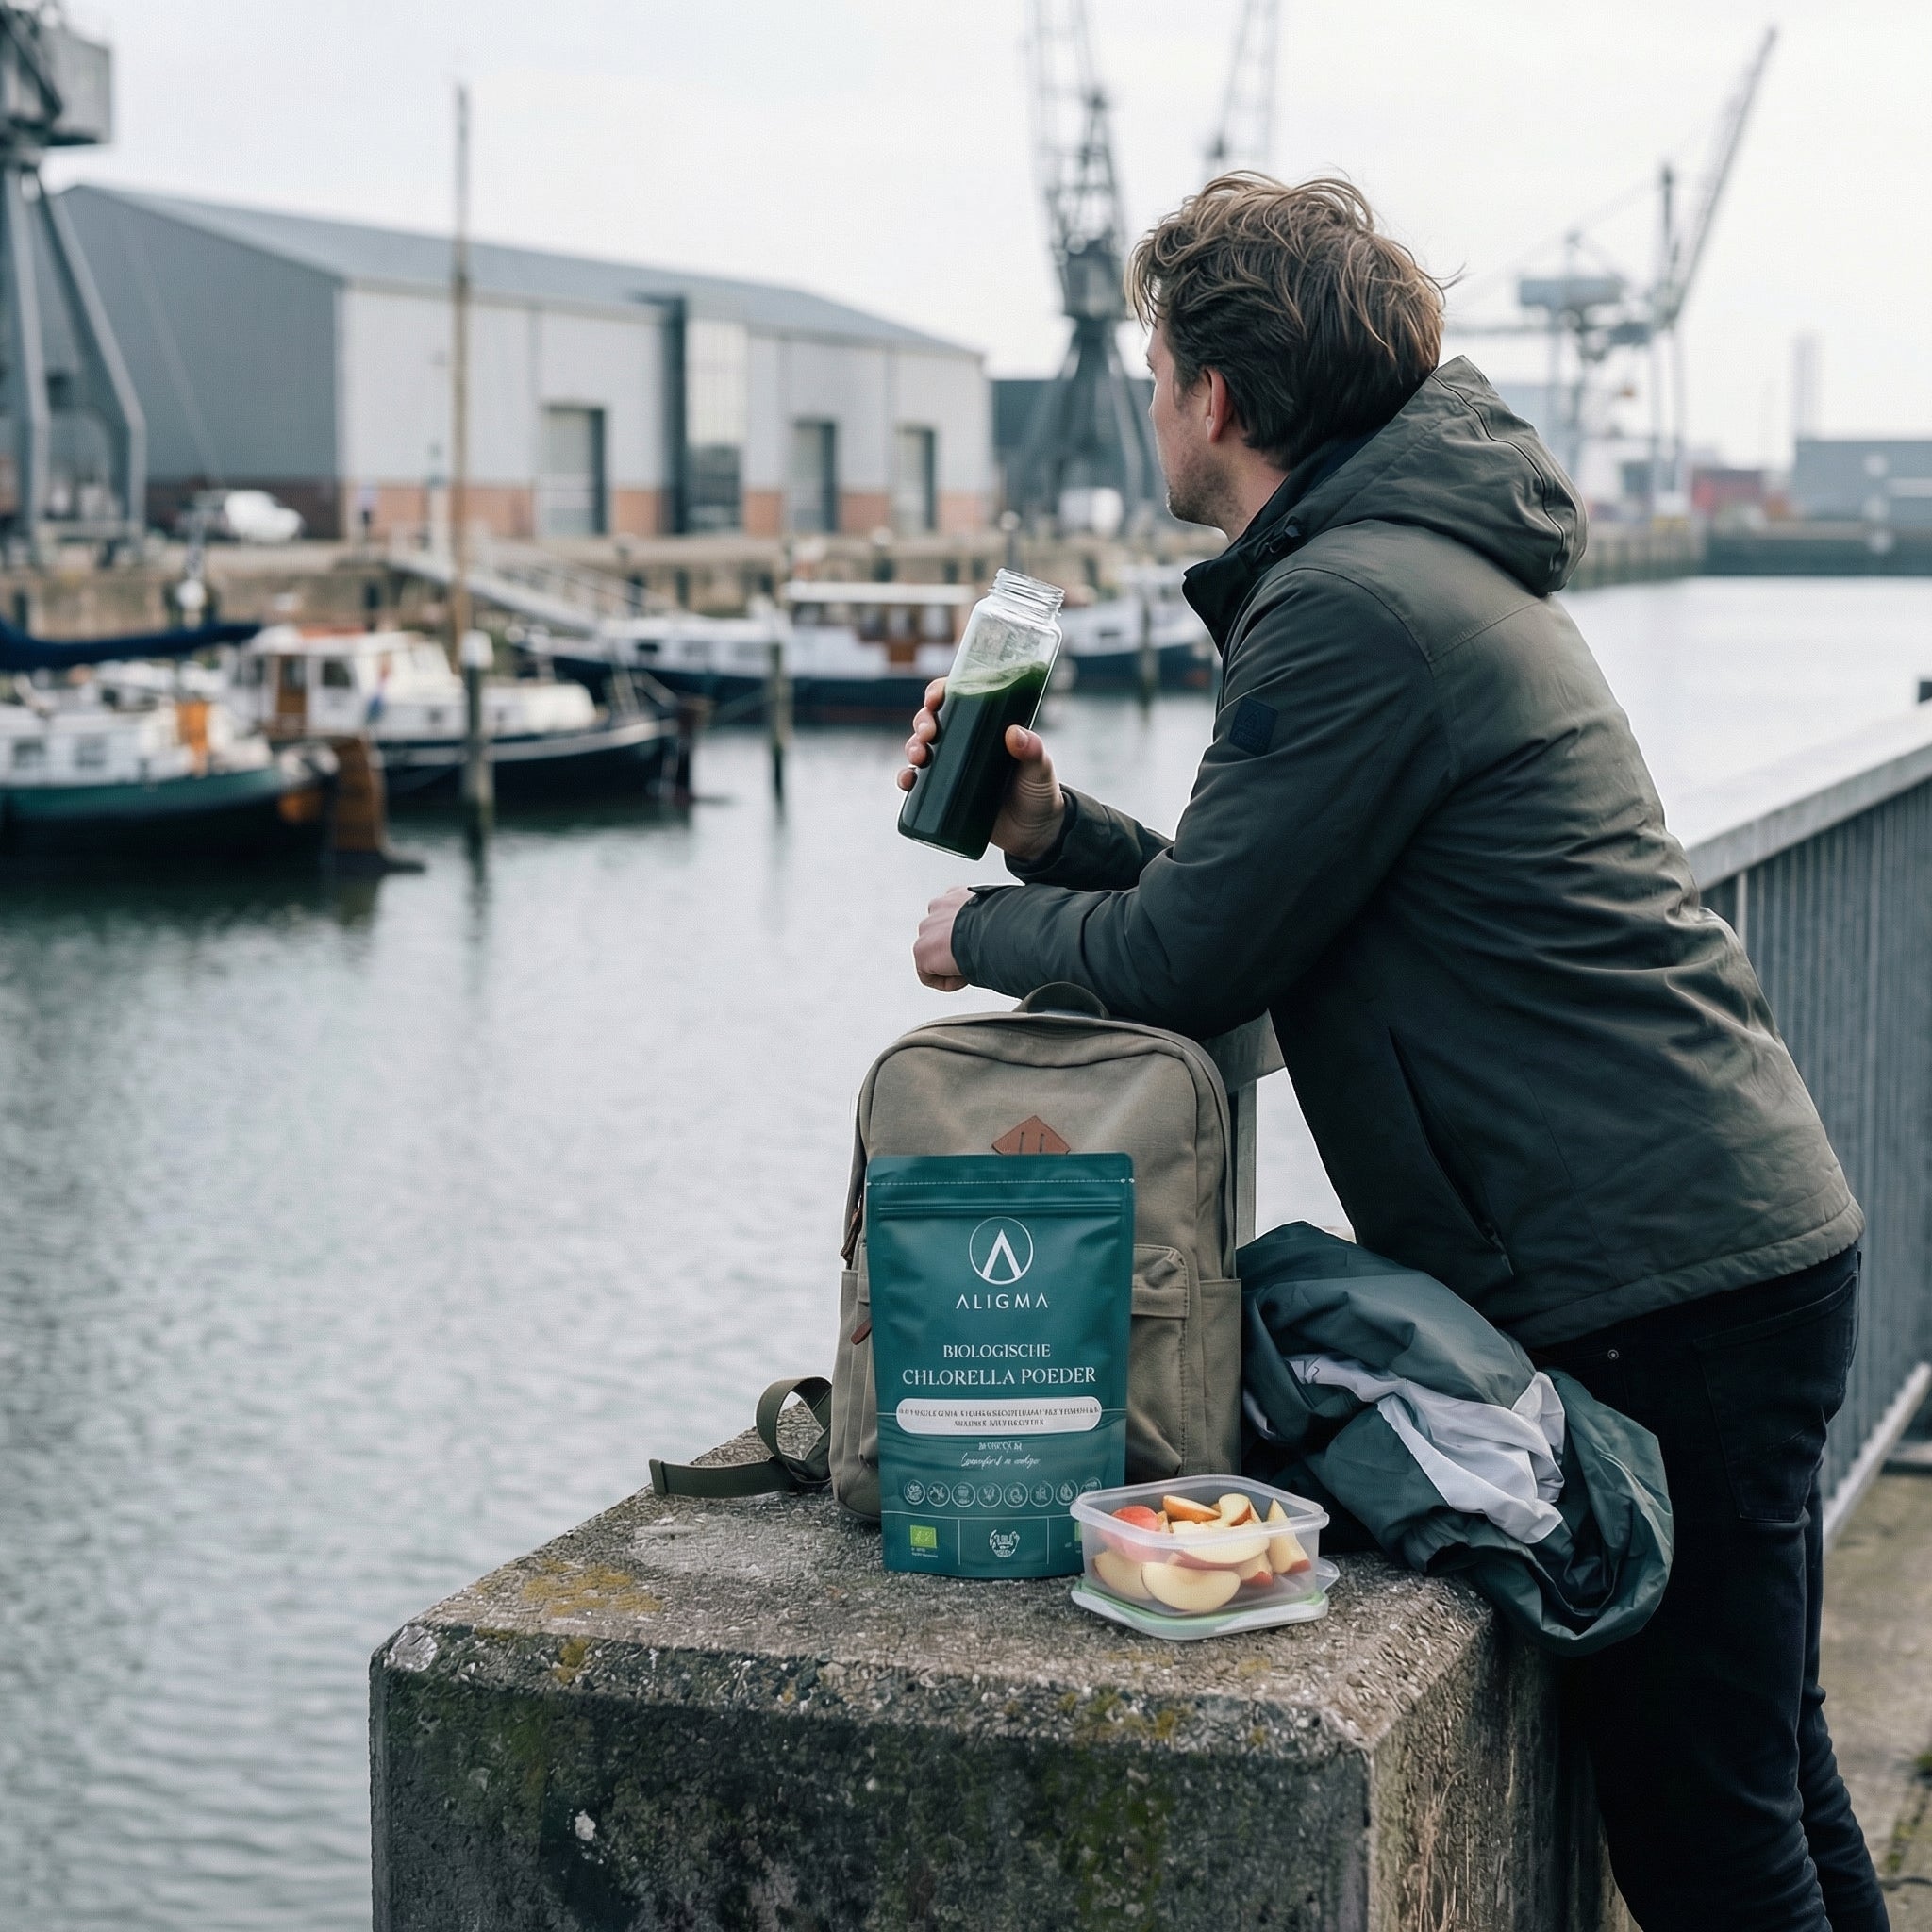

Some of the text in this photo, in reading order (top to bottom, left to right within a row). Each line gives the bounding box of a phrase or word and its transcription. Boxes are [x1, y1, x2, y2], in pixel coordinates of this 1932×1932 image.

[955, 1293, 1049, 1309] ALIGMA
[942, 1344, 1052, 1358] BIOLOGISCHE
[902, 1367, 1096, 1386] CHLORELLA POEDER
